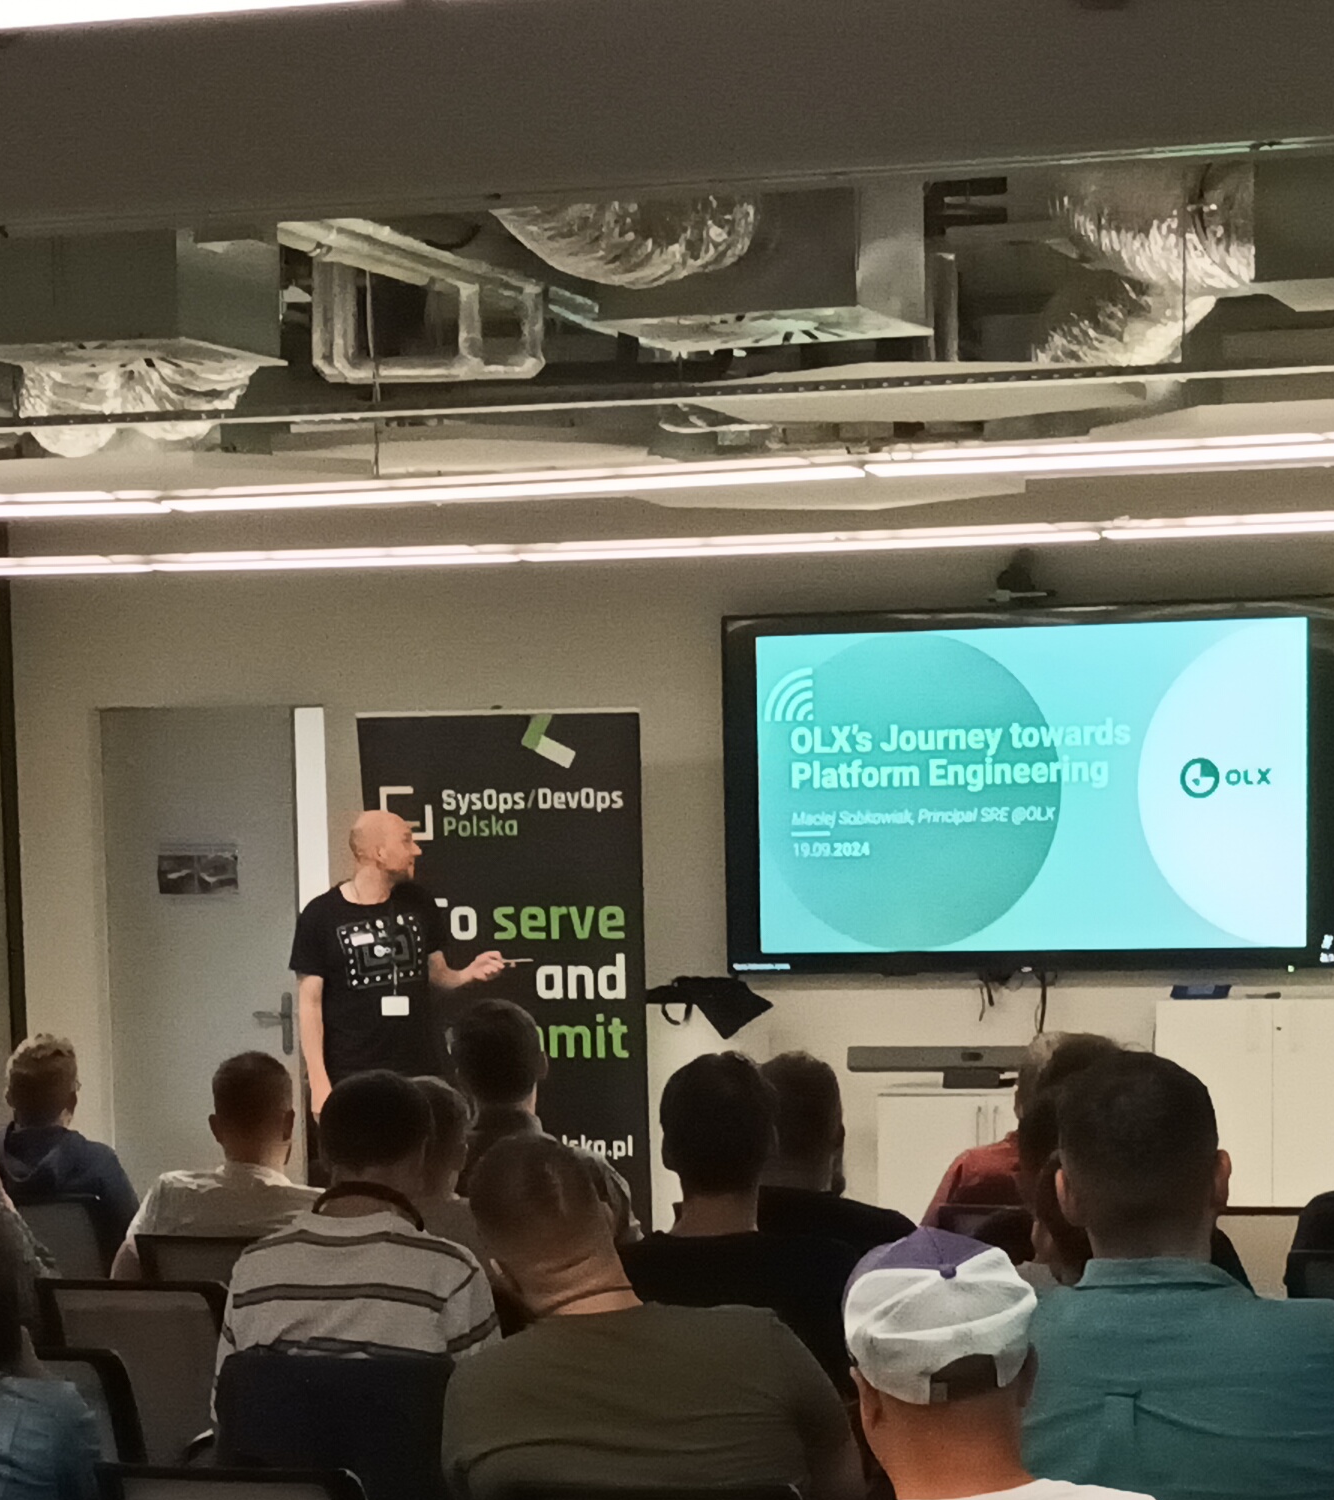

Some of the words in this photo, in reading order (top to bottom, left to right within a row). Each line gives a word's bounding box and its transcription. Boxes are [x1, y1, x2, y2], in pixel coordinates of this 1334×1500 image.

[790, 724, 873, 755] OLX's
[880, 723, 1003, 757] Journey
[1009, 717, 1132, 749] towards
[791, 758, 920, 789] Platform
[928, 754, 1109, 792] Engineering
[1225, 767, 1272, 786] OLX
[441, 787, 624, 815] SysOps/DevOps
[917, 807, 978, 826] Principal
[980, 806, 1010, 822] SRE
[1011, 805, 1056, 826] @OLX
[443, 814, 518, 838] Polska
[434, 898, 477, 940] o
[493, 906, 626, 940] serve
[536, 952, 627, 1000] and
